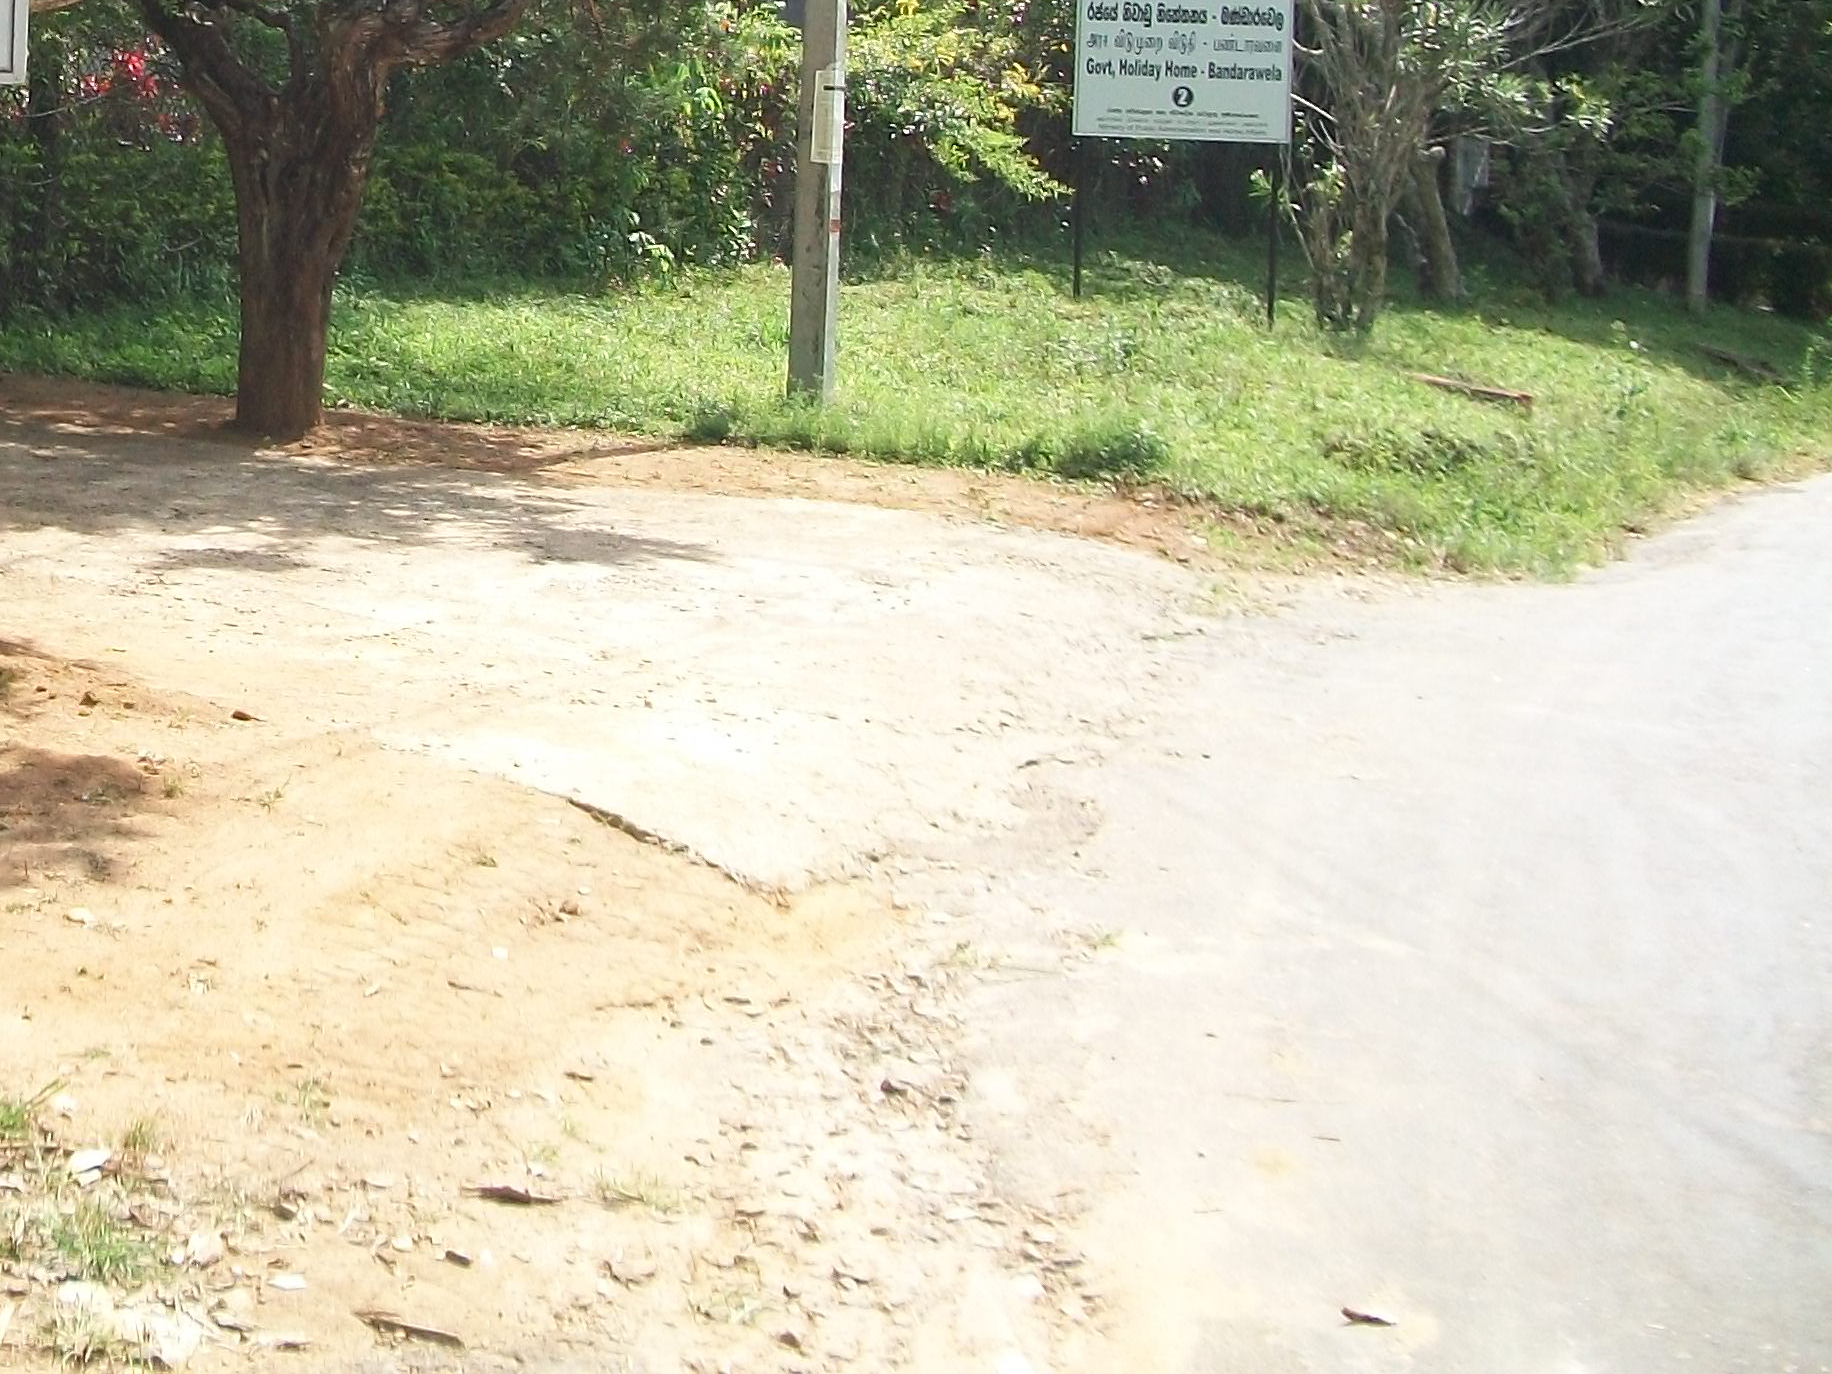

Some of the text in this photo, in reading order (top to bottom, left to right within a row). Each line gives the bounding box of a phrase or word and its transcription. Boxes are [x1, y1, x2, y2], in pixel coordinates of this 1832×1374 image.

[1087, 58, 1116, 79] Govt,
[1120, 59, 1162, 81] Holiday
[1165, 61, 1198, 78] Home
[1209, 62, 1282, 81] Bandarawela
[1176, 88, 1189, 105] 2
